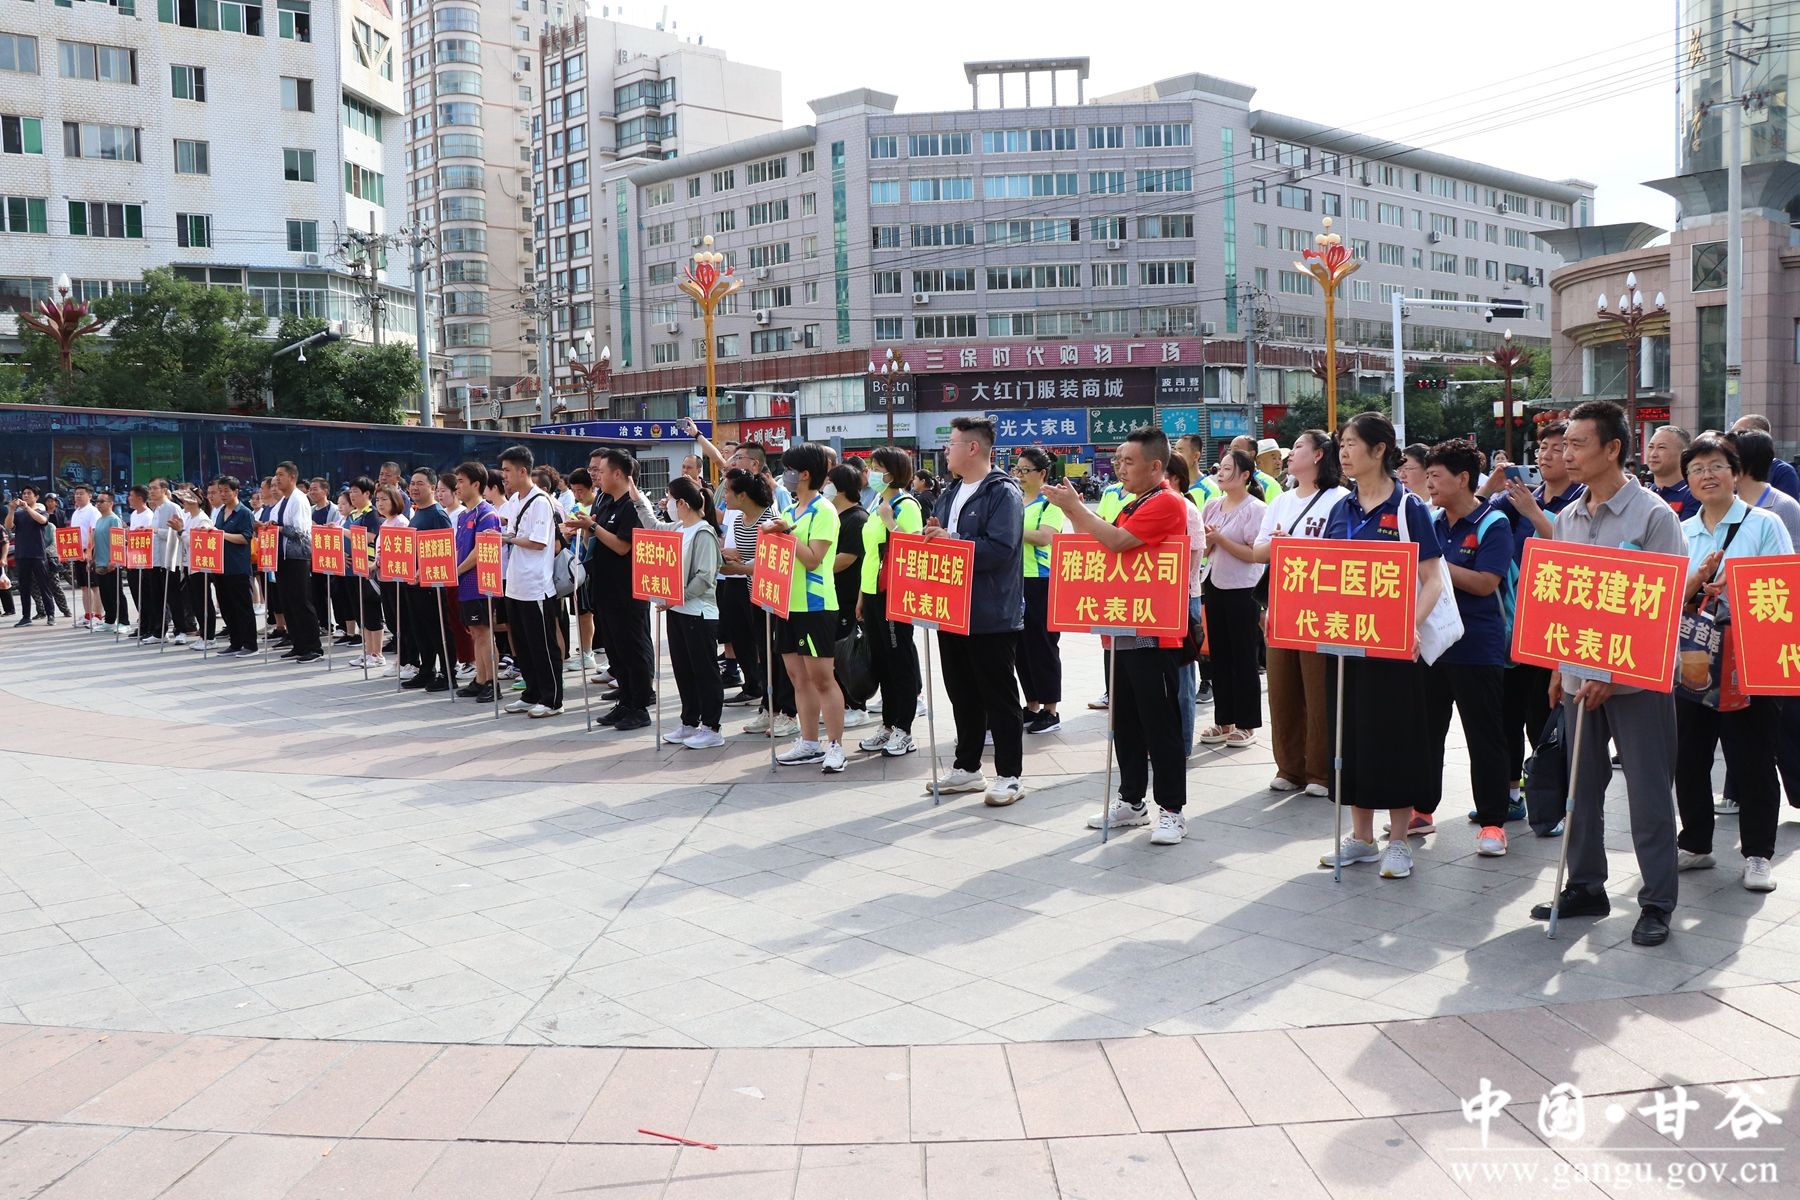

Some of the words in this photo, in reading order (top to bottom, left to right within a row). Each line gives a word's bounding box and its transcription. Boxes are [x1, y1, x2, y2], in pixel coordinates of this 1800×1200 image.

[926, 343, 1181, 369] 三保时代购物广场
[971, 378, 1124, 401] 大红门服装商城
[1161, 377, 1199, 387] 波司登
[1000, 418, 1077, 437] 光大家电
[62, 548, 79, 557] 代表队
[194, 536, 216, 551] 六峰
[314, 533, 340, 551] 教育局
[384, 535, 412, 554] 公安局
[419, 538, 452, 558] 自然资源局
[195, 556, 215, 568] 代表队
[319, 556, 337, 569] 代表队
[478, 543, 498, 564] 县委党校
[636, 540, 677, 568] 疾控中心
[758, 539, 791, 576] 中医院
[387, 560, 408, 575] 代表队
[425, 565, 448, 580] 代表队
[896, 546, 964, 587] 十里铺卫生院
[1060, 549, 1178, 585] 雅路人公司
[1282, 556, 1401, 599] 济仁医院
[481, 572, 496, 588] 代表队
[641, 574, 672, 596] 代表队
[758, 577, 780, 605] 代表队
[1531, 560, 1666, 620] 森茂建材
[902, 589, 951, 620] 代表队
[1076, 595, 1157, 624] 代表队
[1747, 577, 1793, 624] 裁
[1295, 609, 1381, 644] 代表队
[1543, 622, 1637, 669] 代表队
